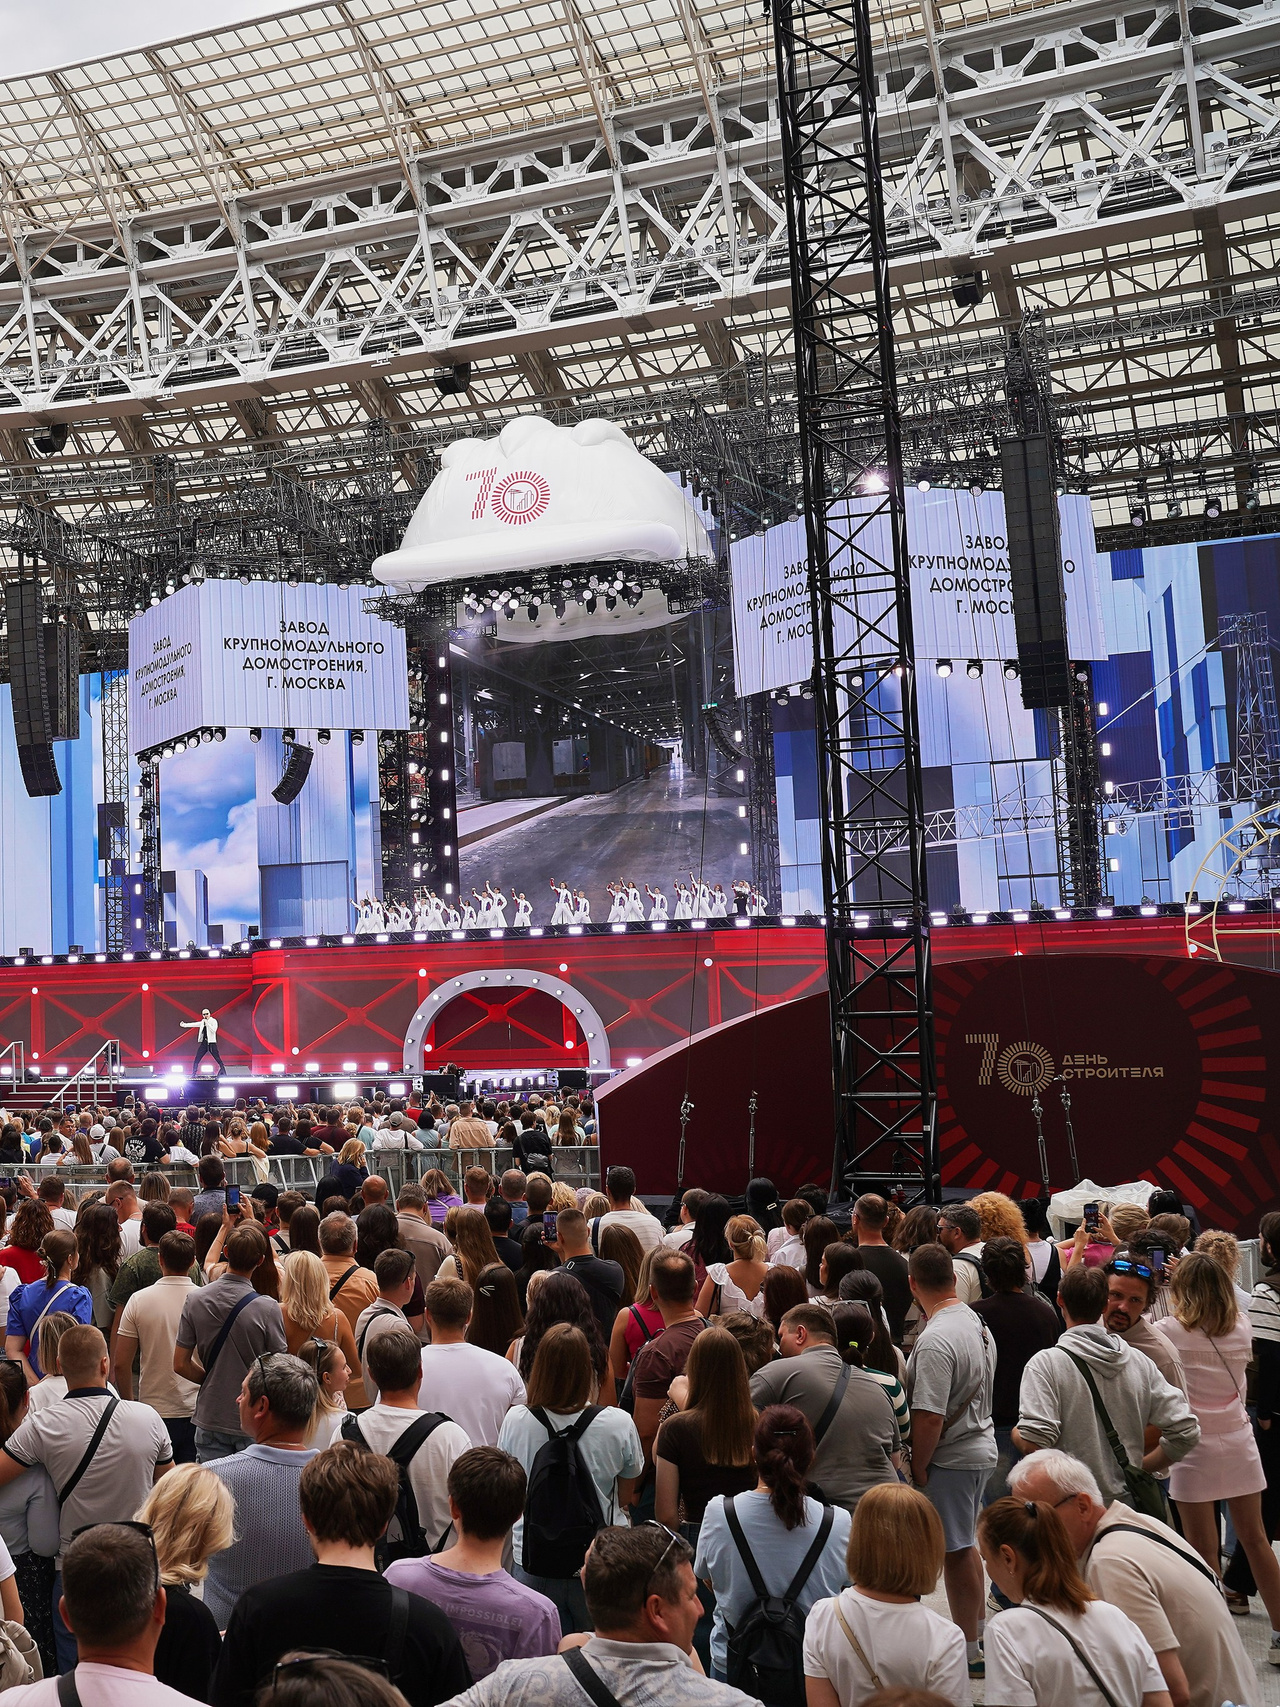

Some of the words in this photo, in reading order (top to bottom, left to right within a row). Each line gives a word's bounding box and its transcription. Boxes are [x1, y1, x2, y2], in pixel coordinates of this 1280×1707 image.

[465, 466, 551, 525] 70
[965, 534, 1010, 551] ЗАВО
[783, 557, 819, 580] ЗАВО
[908, 554, 1076, 574] КРУПНОМОДО
[956, 600, 968, 614] Г.
[972, 600, 1016, 615] МОС
[279, 620, 330, 636] ЗАВОД
[776, 630, 785, 644] Г.
[787, 619, 836, 642] МОС
[152, 635, 172, 655] ЗАВОД
[223, 637, 385, 655] КРУПНОМОДУЛЬНОГО
[135, 642, 192, 681] КРУПНОМОДУЛЬНОГО
[242, 656, 368, 674] ДОМОСТРОЕНИЯ,
[140, 665, 186, 698] ДОМОСТРОЕНИЯ,
[267, 676, 277, 689] Г.
[282, 676, 346, 690] МОСКВА
[153, 687, 178, 709] МОСКВА
[965, 1033, 1055, 1097] 70
[1061, 1053, 1108, 1066] ДЕНЬ
[1064, 1066, 1165, 1080] СТРОИТЕЛЯ
[445, 1602, 523, 1627] IMPOSSIBLE!
